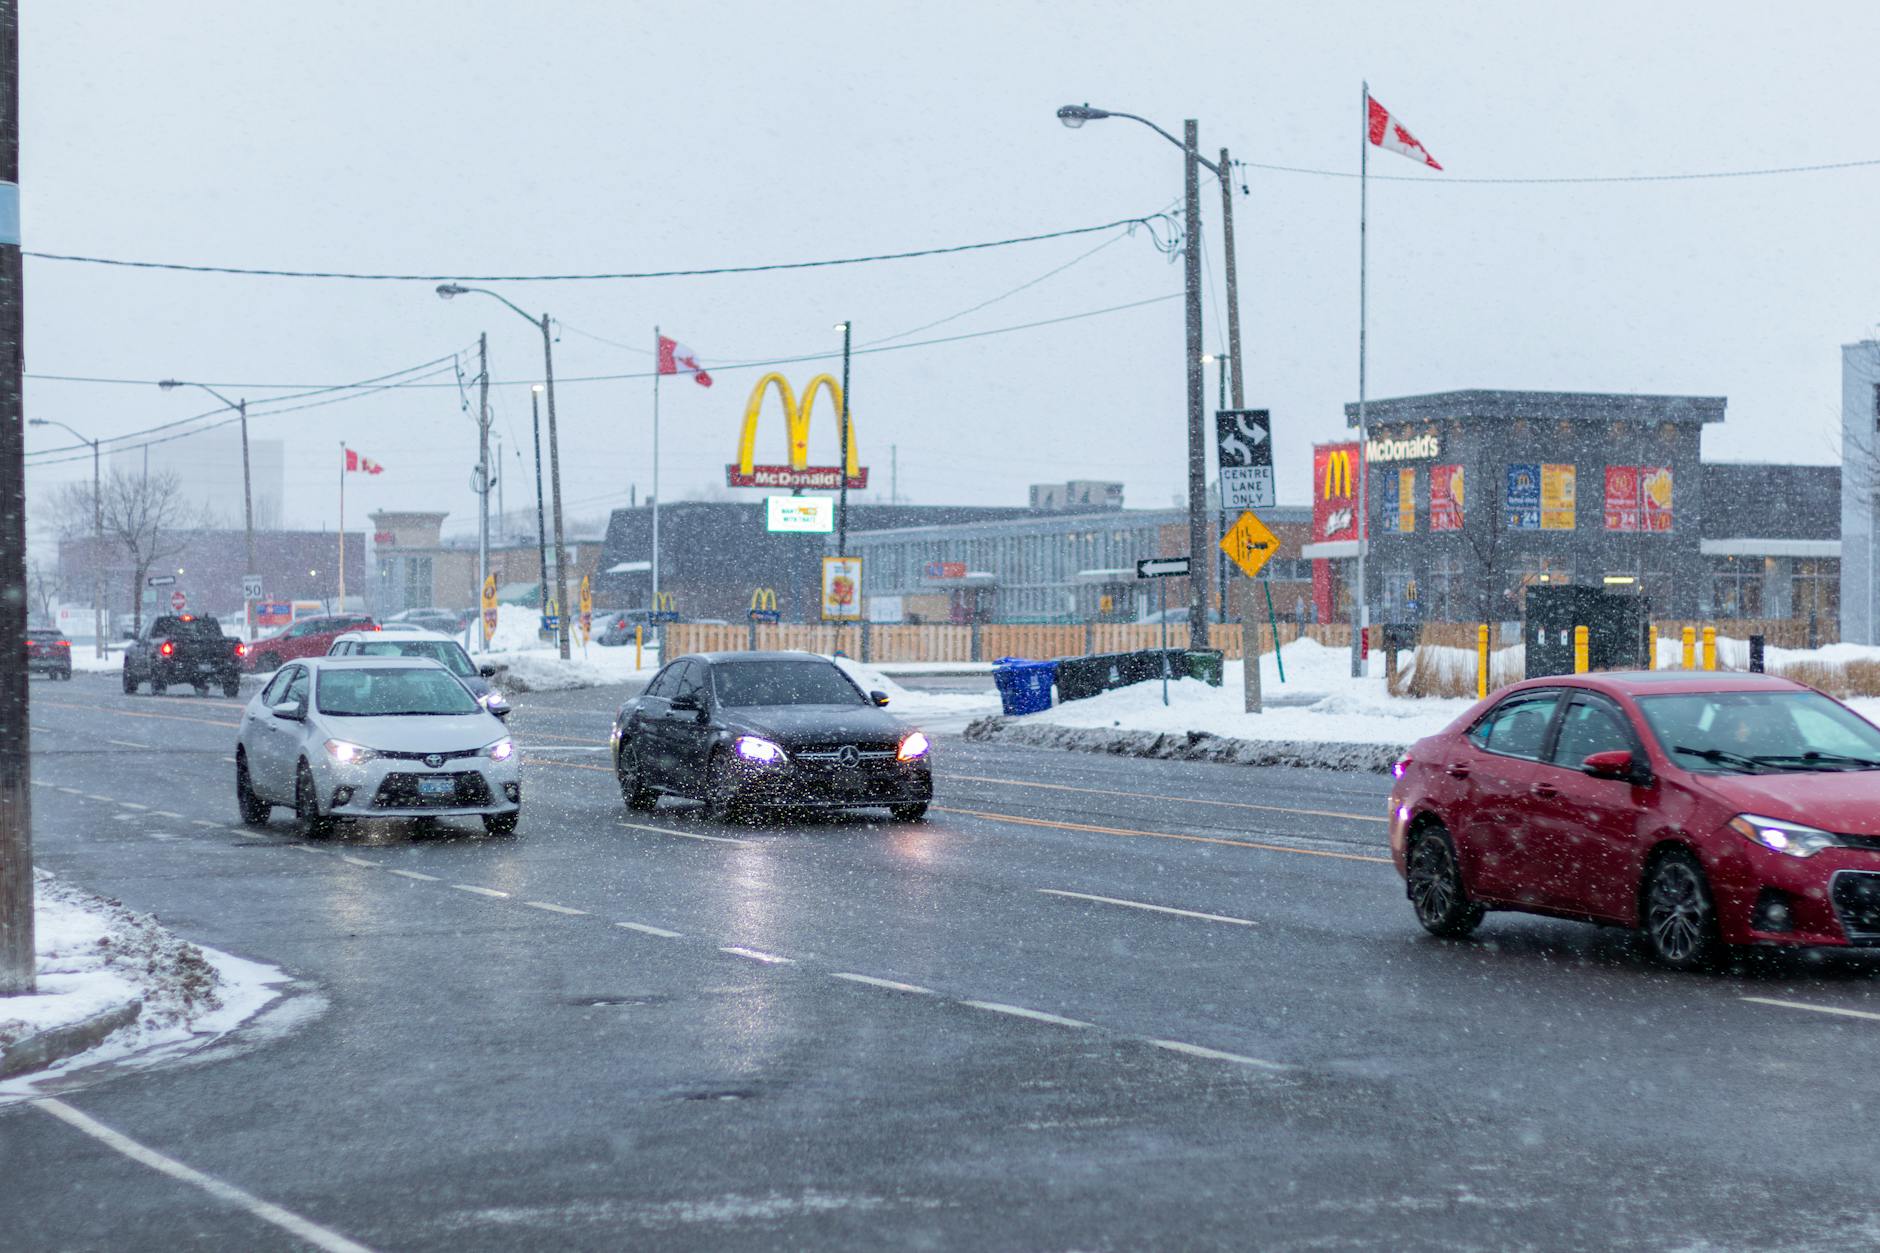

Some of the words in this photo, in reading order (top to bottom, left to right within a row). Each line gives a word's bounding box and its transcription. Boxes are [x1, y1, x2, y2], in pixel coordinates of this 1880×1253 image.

[1366, 433, 1438, 462] McDonald's
[1224, 469, 1269, 479] CENTRE
[1232, 481, 1262, 492] LANE
[1232, 493, 1263, 504] ONLY
[245, 584, 261, 597] 50
